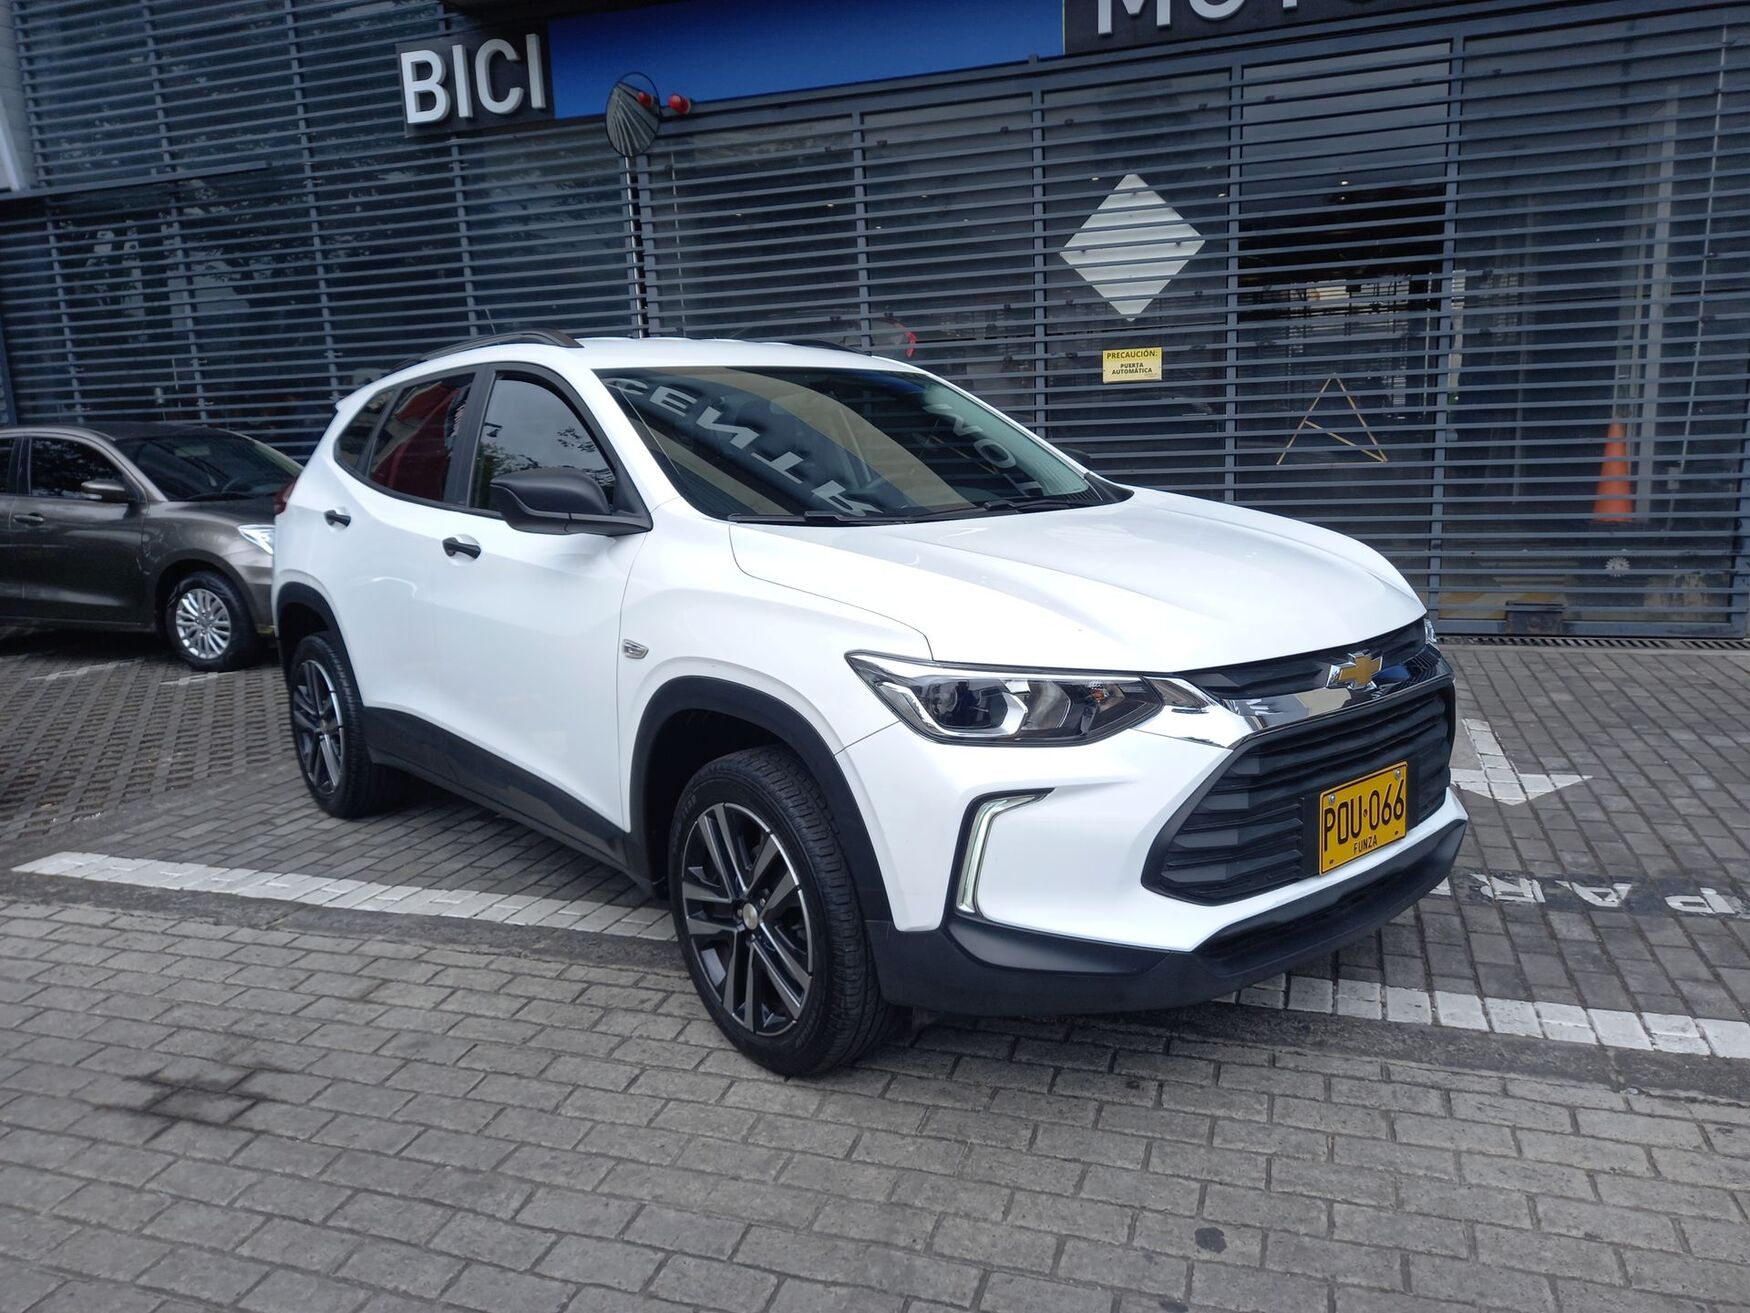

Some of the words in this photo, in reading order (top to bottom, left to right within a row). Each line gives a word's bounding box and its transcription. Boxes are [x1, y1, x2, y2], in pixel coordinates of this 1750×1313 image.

[401, 33, 546, 124] BICI
[1107, 350, 1159, 360] PRECAUCIÓN:
[1353, 834, 1378, 855] FUNZA
